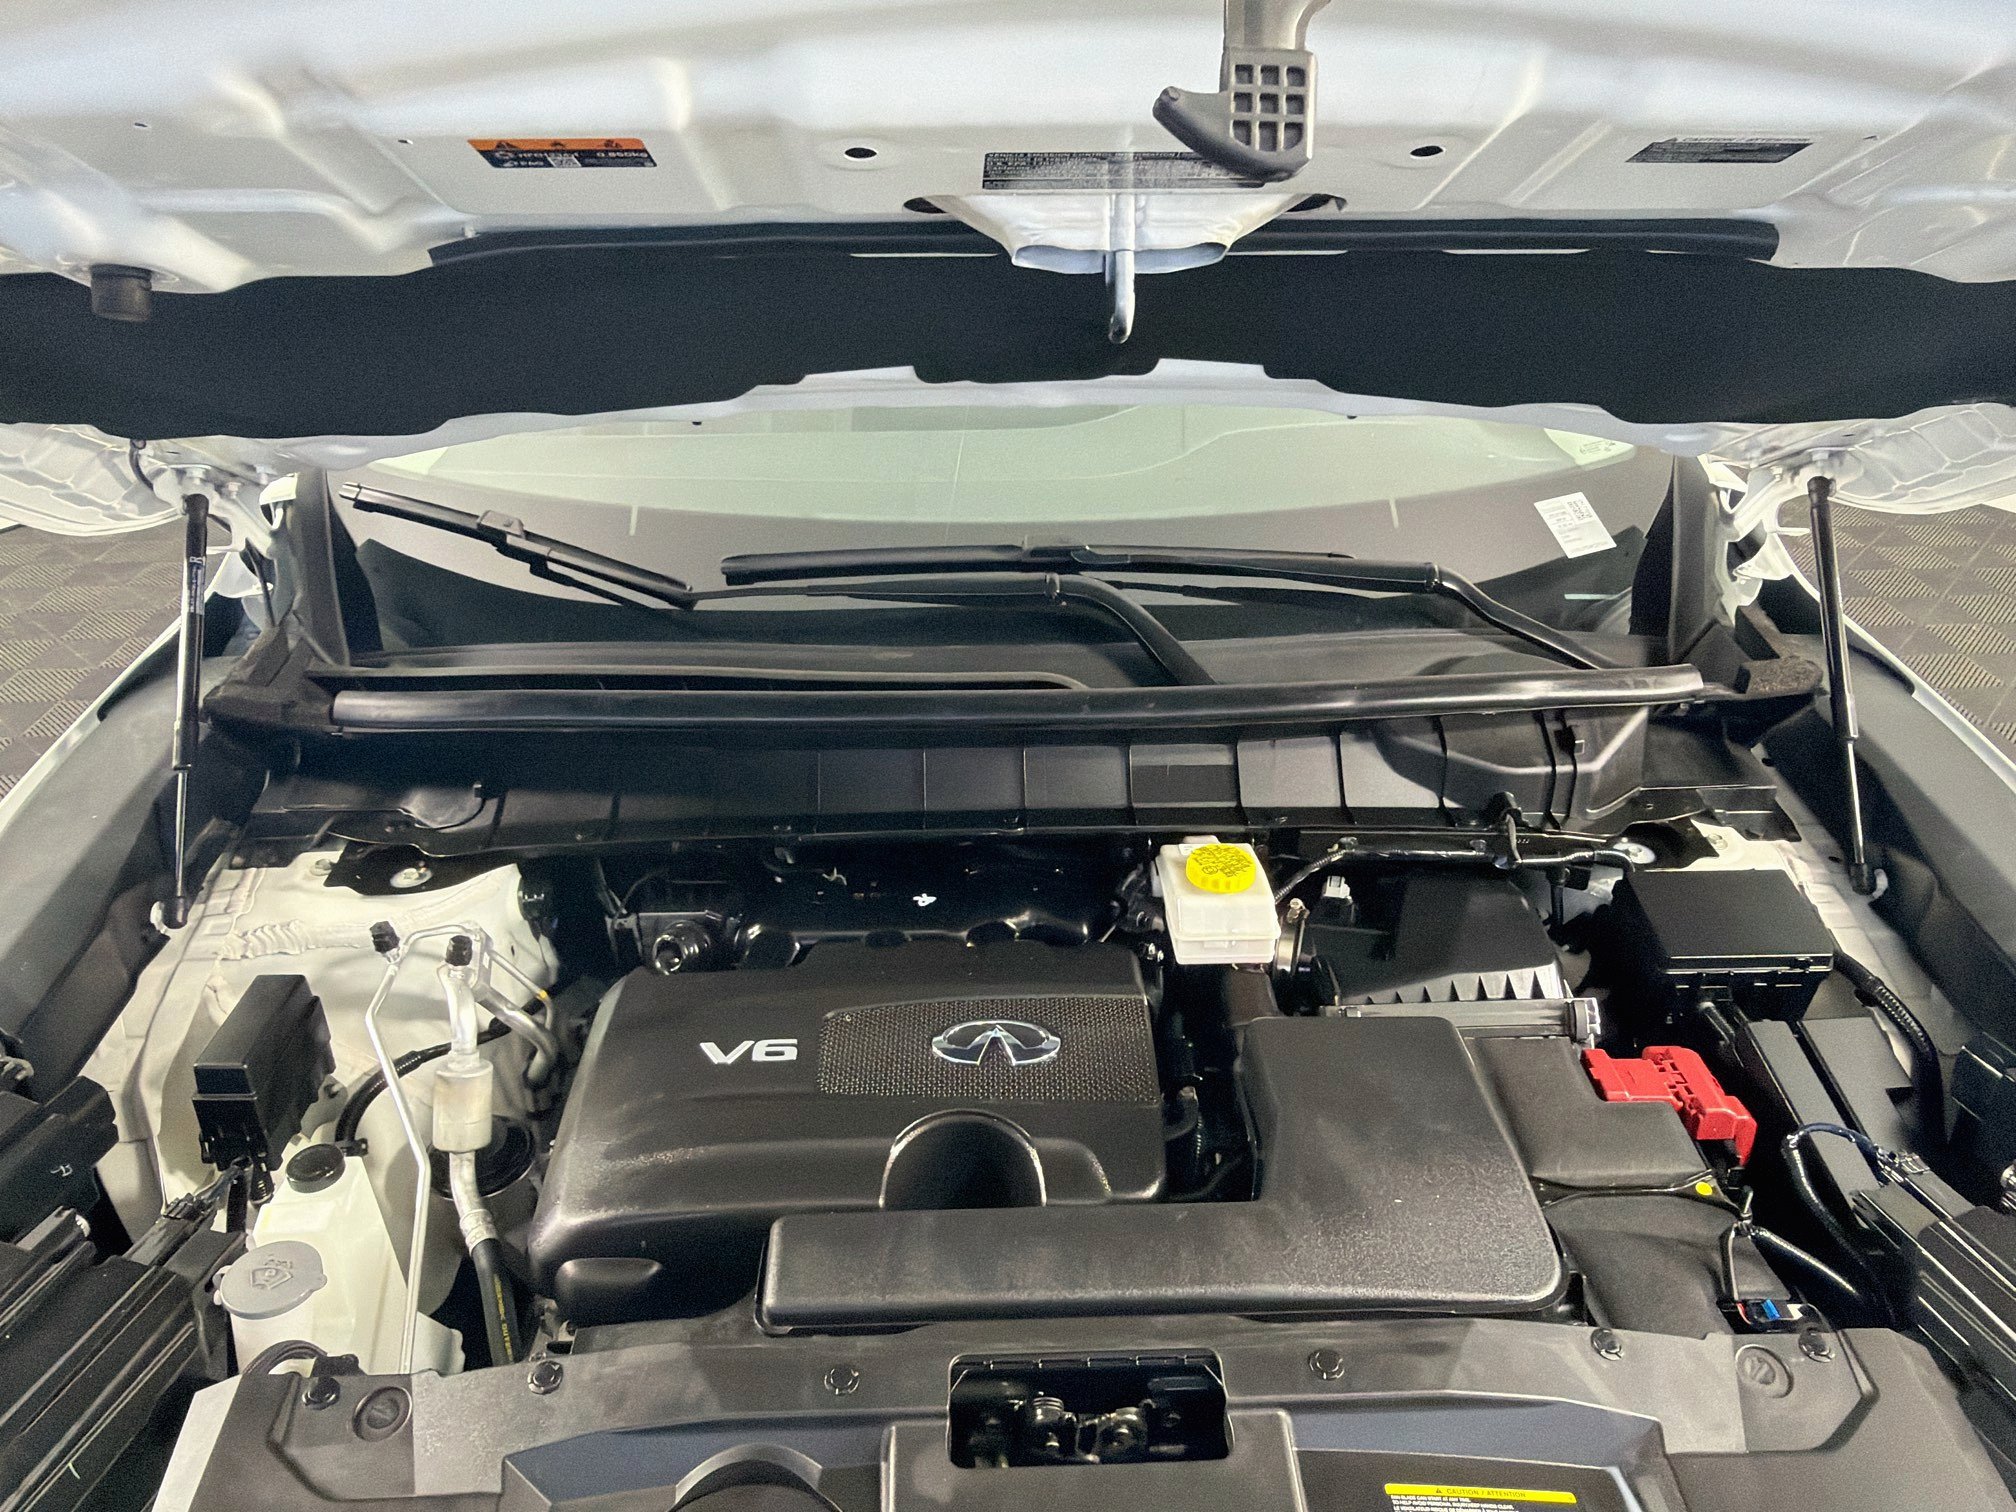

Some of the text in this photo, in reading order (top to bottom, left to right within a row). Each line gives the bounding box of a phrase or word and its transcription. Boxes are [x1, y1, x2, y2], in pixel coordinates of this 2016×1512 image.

[700, 1039, 798, 1064] V6
[1446, 1488, 1480, 1496] CAUTION
[1487, 1490, 1527, 1498] ATTENTION
